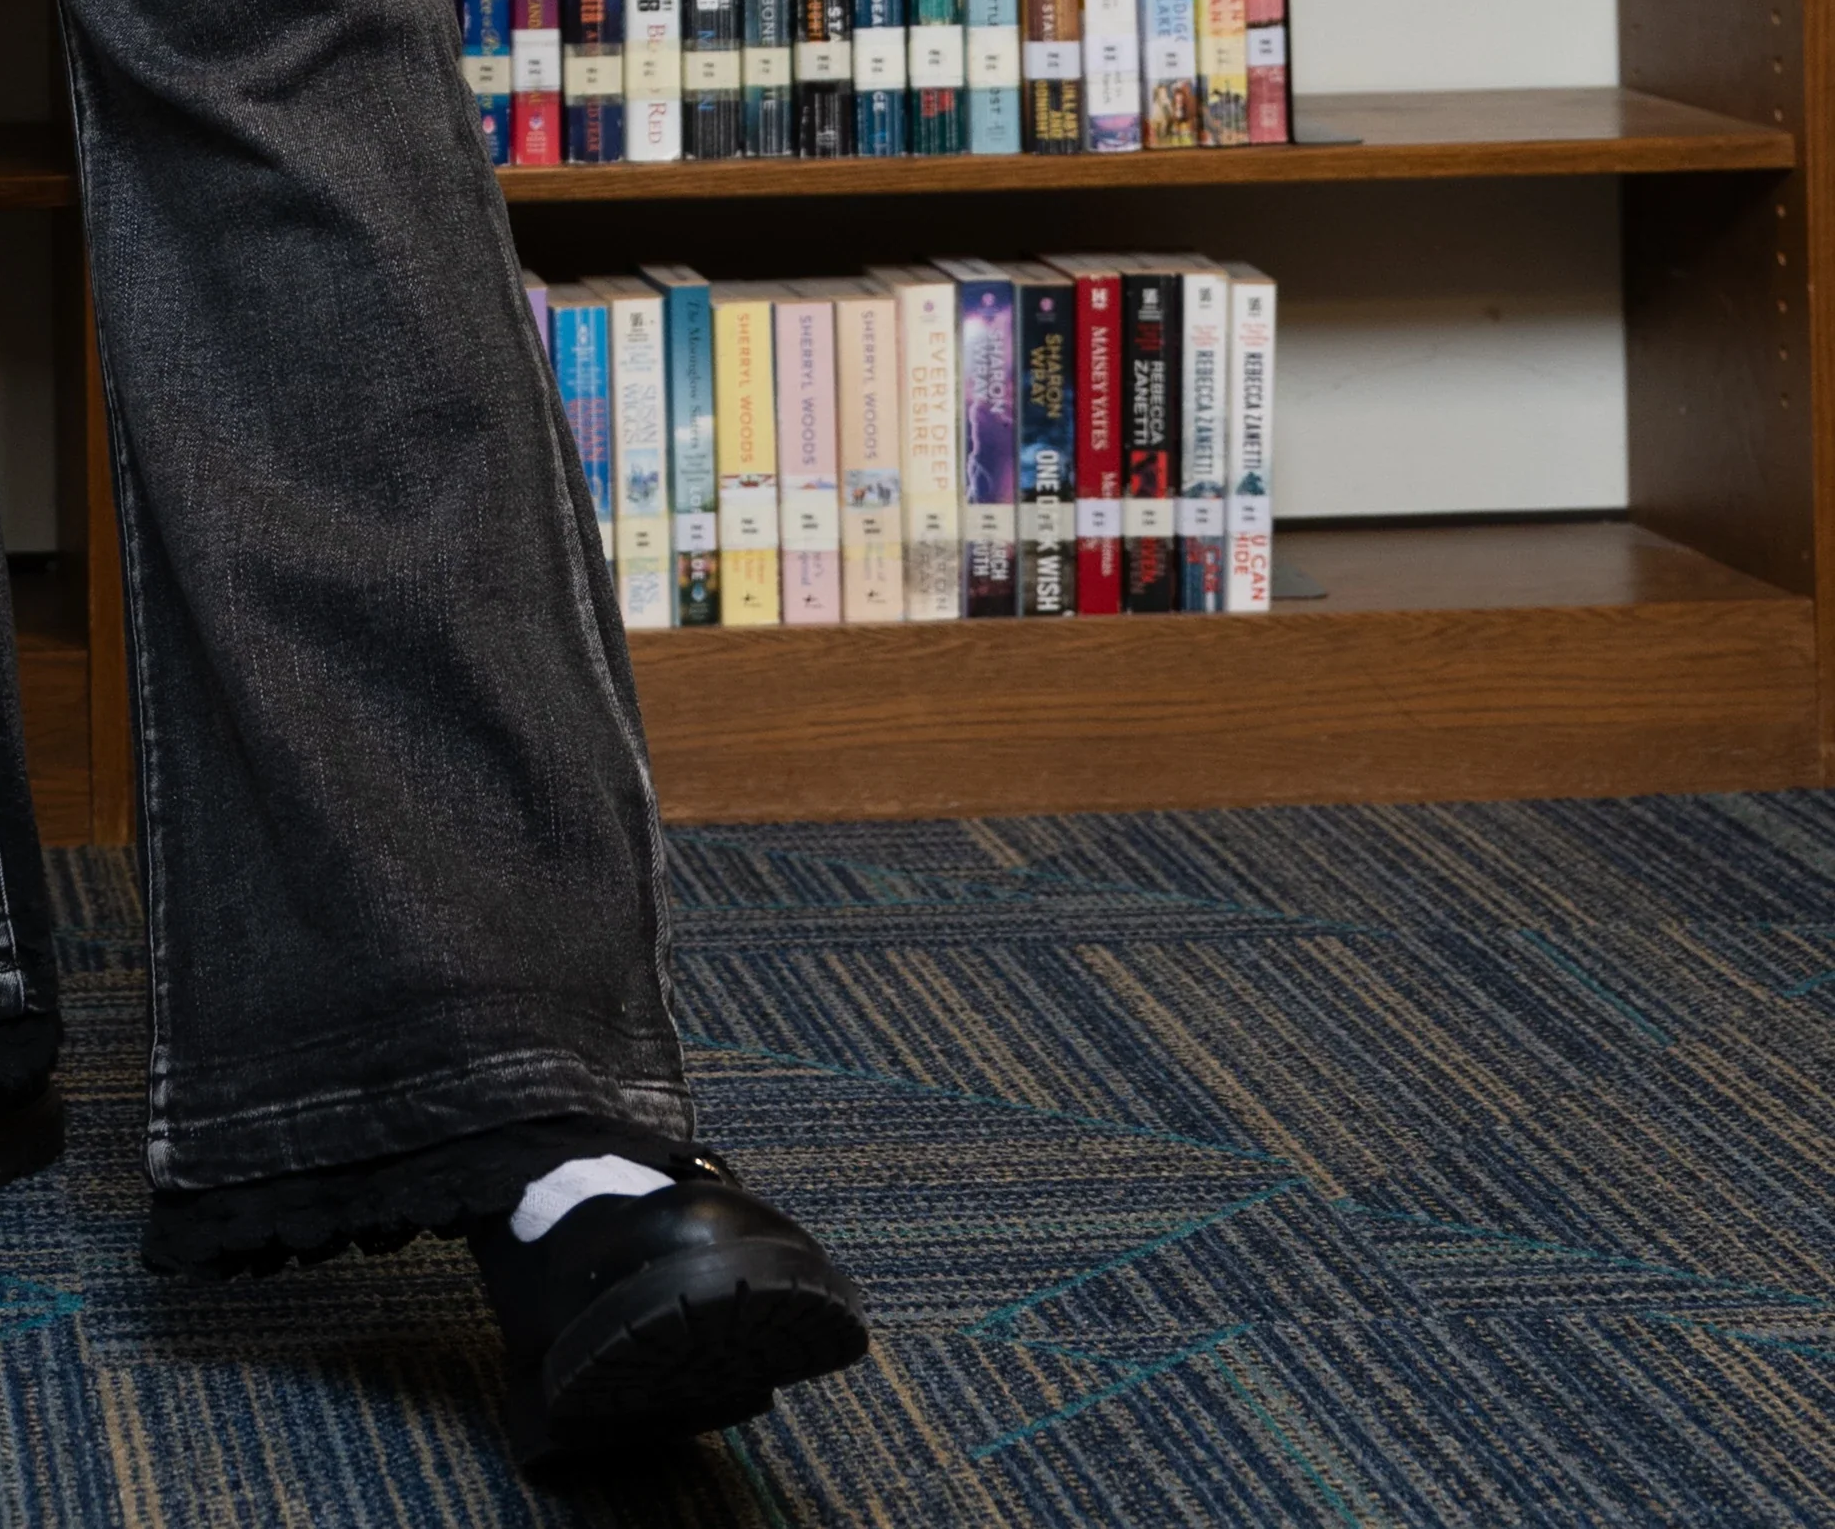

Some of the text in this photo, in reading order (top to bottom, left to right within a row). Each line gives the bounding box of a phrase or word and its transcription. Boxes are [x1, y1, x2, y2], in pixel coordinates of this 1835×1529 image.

[647, 102, 667, 145] RED
[799, 314, 816, 466] SHERRYL WOODS
[912, 366, 928, 457] DESIRE
[928, 331, 947, 491] EVERY DEEP
[1030, 347, 1046, 407] WRAY
[1045, 333, 1062, 419] SHARON
[1090, 326, 1109, 450] MAISEY YATES
[1133, 359, 1148, 446] ZANETTI
[1150, 360, 1164, 445] REBECCA
[622, 383, 641, 445] WIGGS
[641, 383, 657, 444] SUSAN
[1036, 450, 1060, 491] ONE
[1036, 556, 1061, 611] WISH
[1250, 562, 1267, 601] CAN
